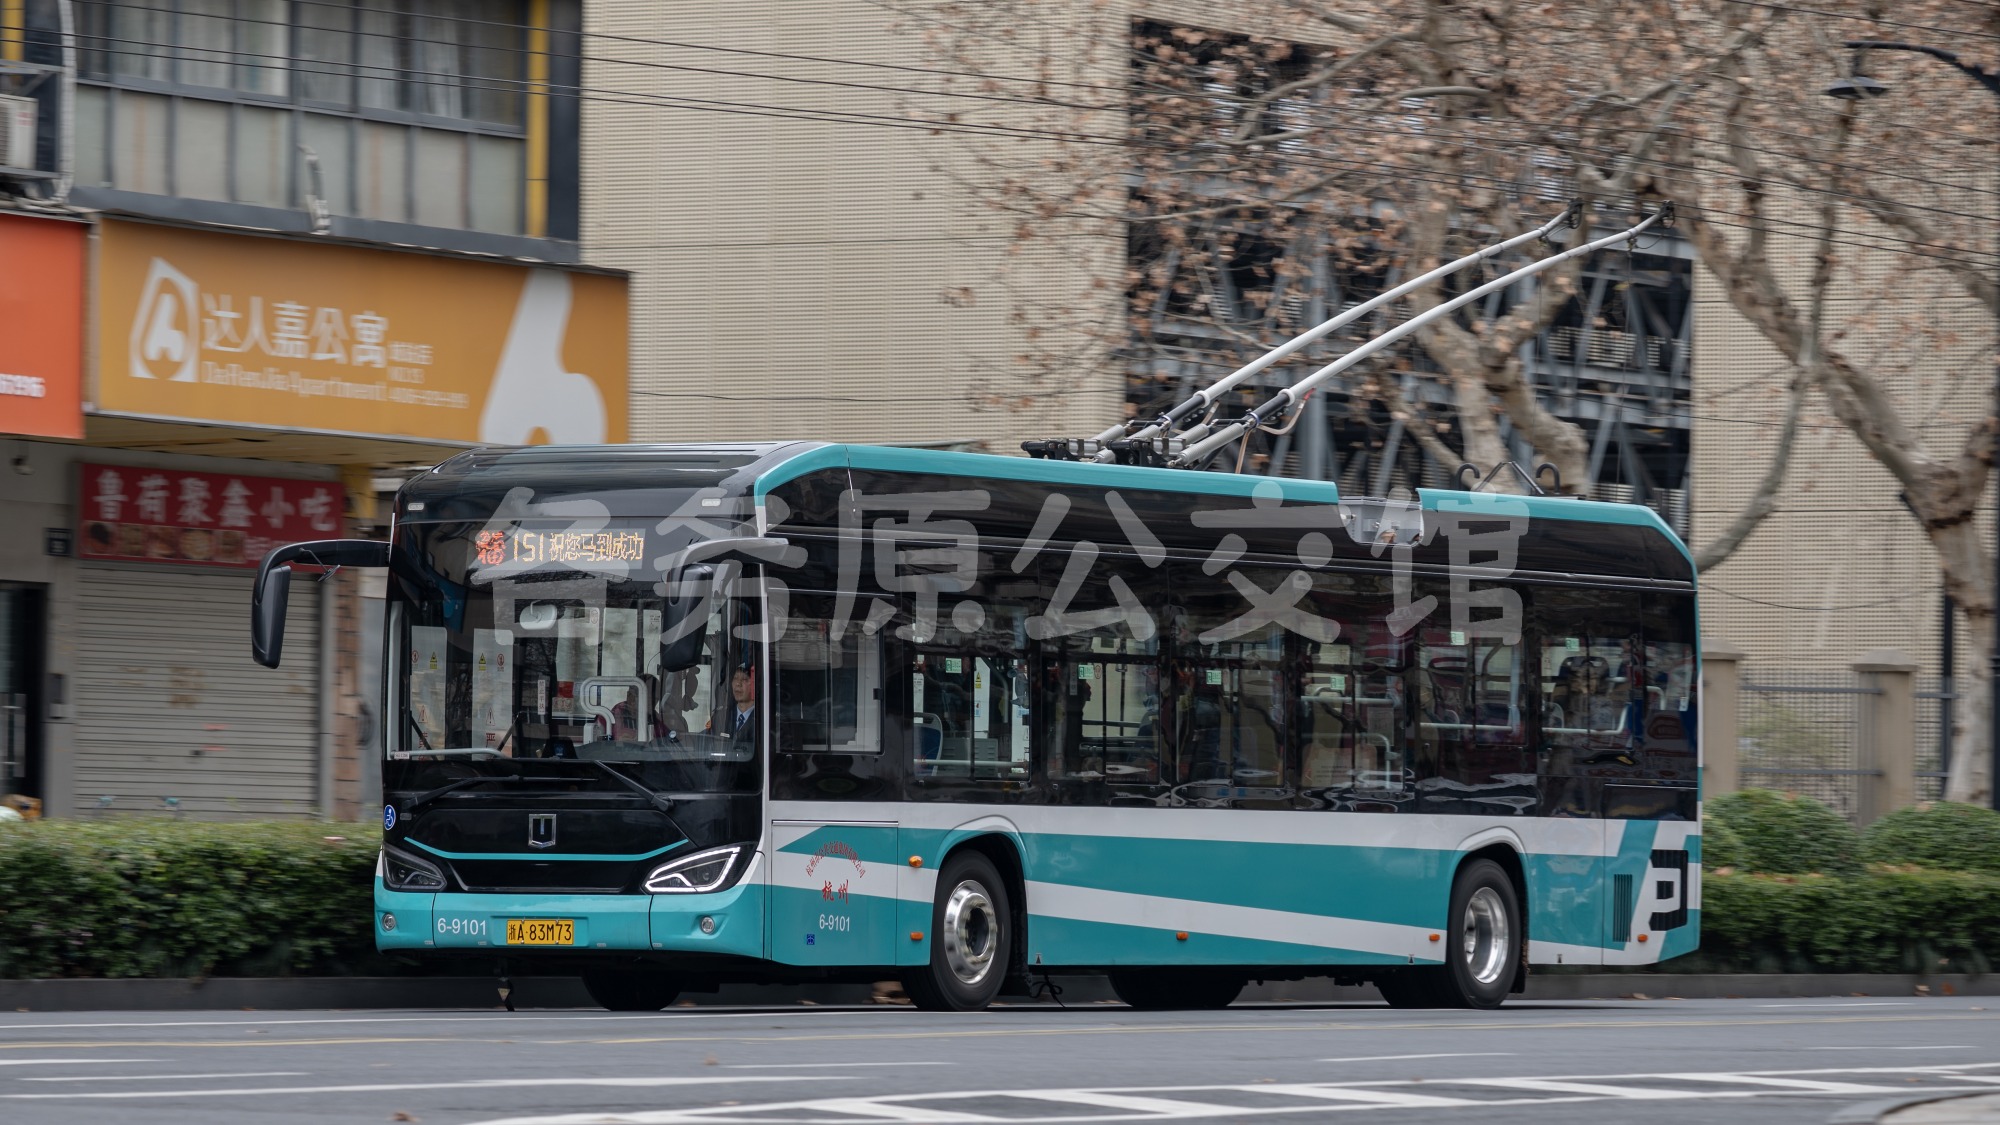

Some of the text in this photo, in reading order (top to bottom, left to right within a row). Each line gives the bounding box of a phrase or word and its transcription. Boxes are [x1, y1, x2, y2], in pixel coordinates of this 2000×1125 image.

[201, 293, 388, 368] 达人嘉公寓
[513, 533, 544, 562] 151
[549, 532, 645, 562] 祝您马到成功
[821, 879, 849, 905] 杭州
[437, 917, 486, 936] 6-9101
[819, 913, 850, 932] 6-9101
